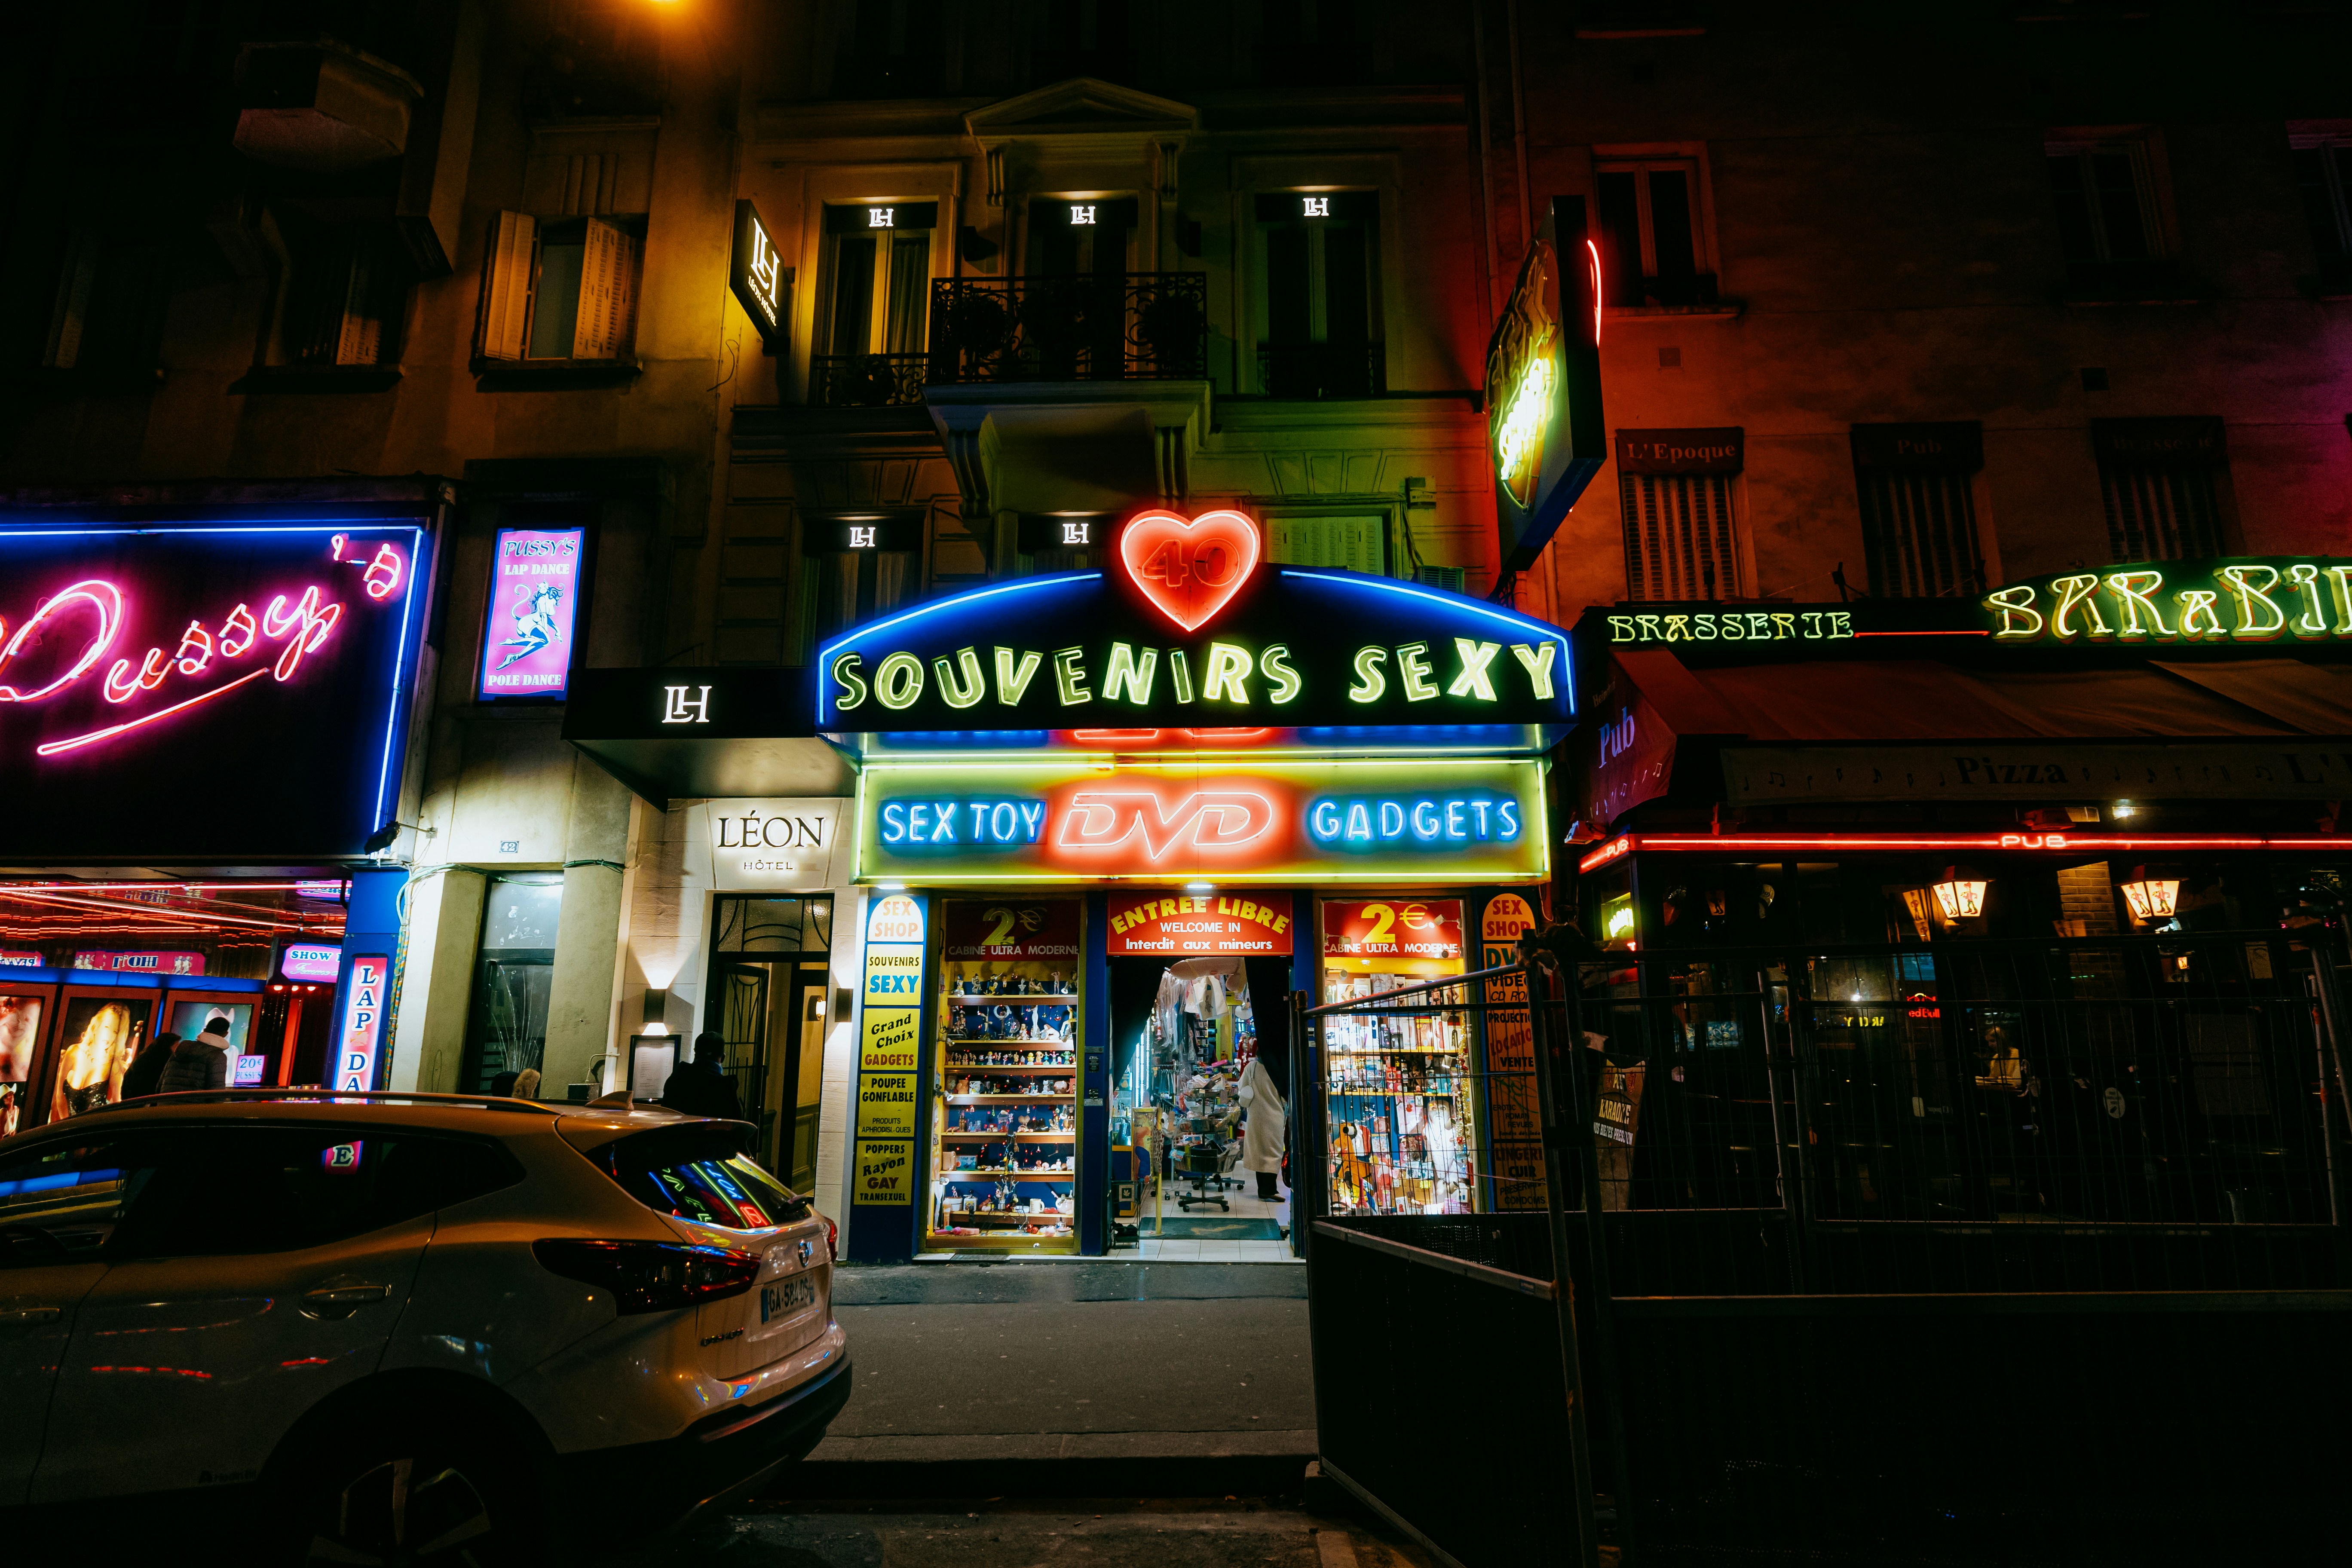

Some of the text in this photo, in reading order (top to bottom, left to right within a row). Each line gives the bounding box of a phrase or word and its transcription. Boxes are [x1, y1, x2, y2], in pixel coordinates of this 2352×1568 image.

[504, 537, 576, 557] PUSSY'S
[504, 564, 570, 576] LAP DANCE
[1142, 538, 1241, 588] 40
[1608, 612, 1853, 642] BRASSERIE
[487, 674, 562, 686] POLE DANCE
[831, 637, 1558, 710] SOUVENIRS SEXY
[1598, 705, 1635, 769] Pub
[1952, 756, 2069, 784] Pizza
[717, 810, 826, 848] LÉON
[882, 792, 1519, 860] SEX TOY DVD GADGETS
[501, 841, 516, 852] 42
[1606, 839, 1629, 857] PUB
[2001, 834, 2067, 848] PUB
[744, 859, 795, 871] HÔTEL
[883, 901, 912, 916] SEX
[1492, 900, 1522, 915] SEX
[1110, 896, 1290, 935] ENTREE LIBRE
[875, 922, 918, 937] SHOP
[1160, 922, 1240, 933] WELCOME IN
[948, 945, 1079, 955] CABINE ULTRA MODERNE
[1126, 937, 1272, 949] Interdit aux mineurs
[1324, 943, 1458, 953] CABINE ULTRA MODERNE
[290, 949, 334, 962] SHOW
[869, 956, 919, 966] SOUVENIRS
[1485, 948, 1517, 970] DV
[869, 975, 919, 993] SEXY
[352, 965, 380, 1031] LAP
[1491, 991, 1528, 1001] CD RO
[871, 1013, 911, 1035] Grand
[876, 1029, 914, 1049] Choix
[1490, 1028, 1532, 1056] LOCATIO
[864, 1054, 914, 1066] GADGETS
[1500, 1057, 1534, 1067] VENTE
[871, 1078, 906, 1088] POUPEE
[862, 1091, 914, 1102] GONFLABLE
[865, 1144, 905, 1154] POPPERS
[1495, 1147, 1543, 1161] LINGERI
[863, 1157, 905, 1177] Rayon
[1509, 1166, 1537, 1178] CUIR
[867, 1177, 899, 1189] GAY
[860, 1193, 906, 1201] TRANSEXUEL
